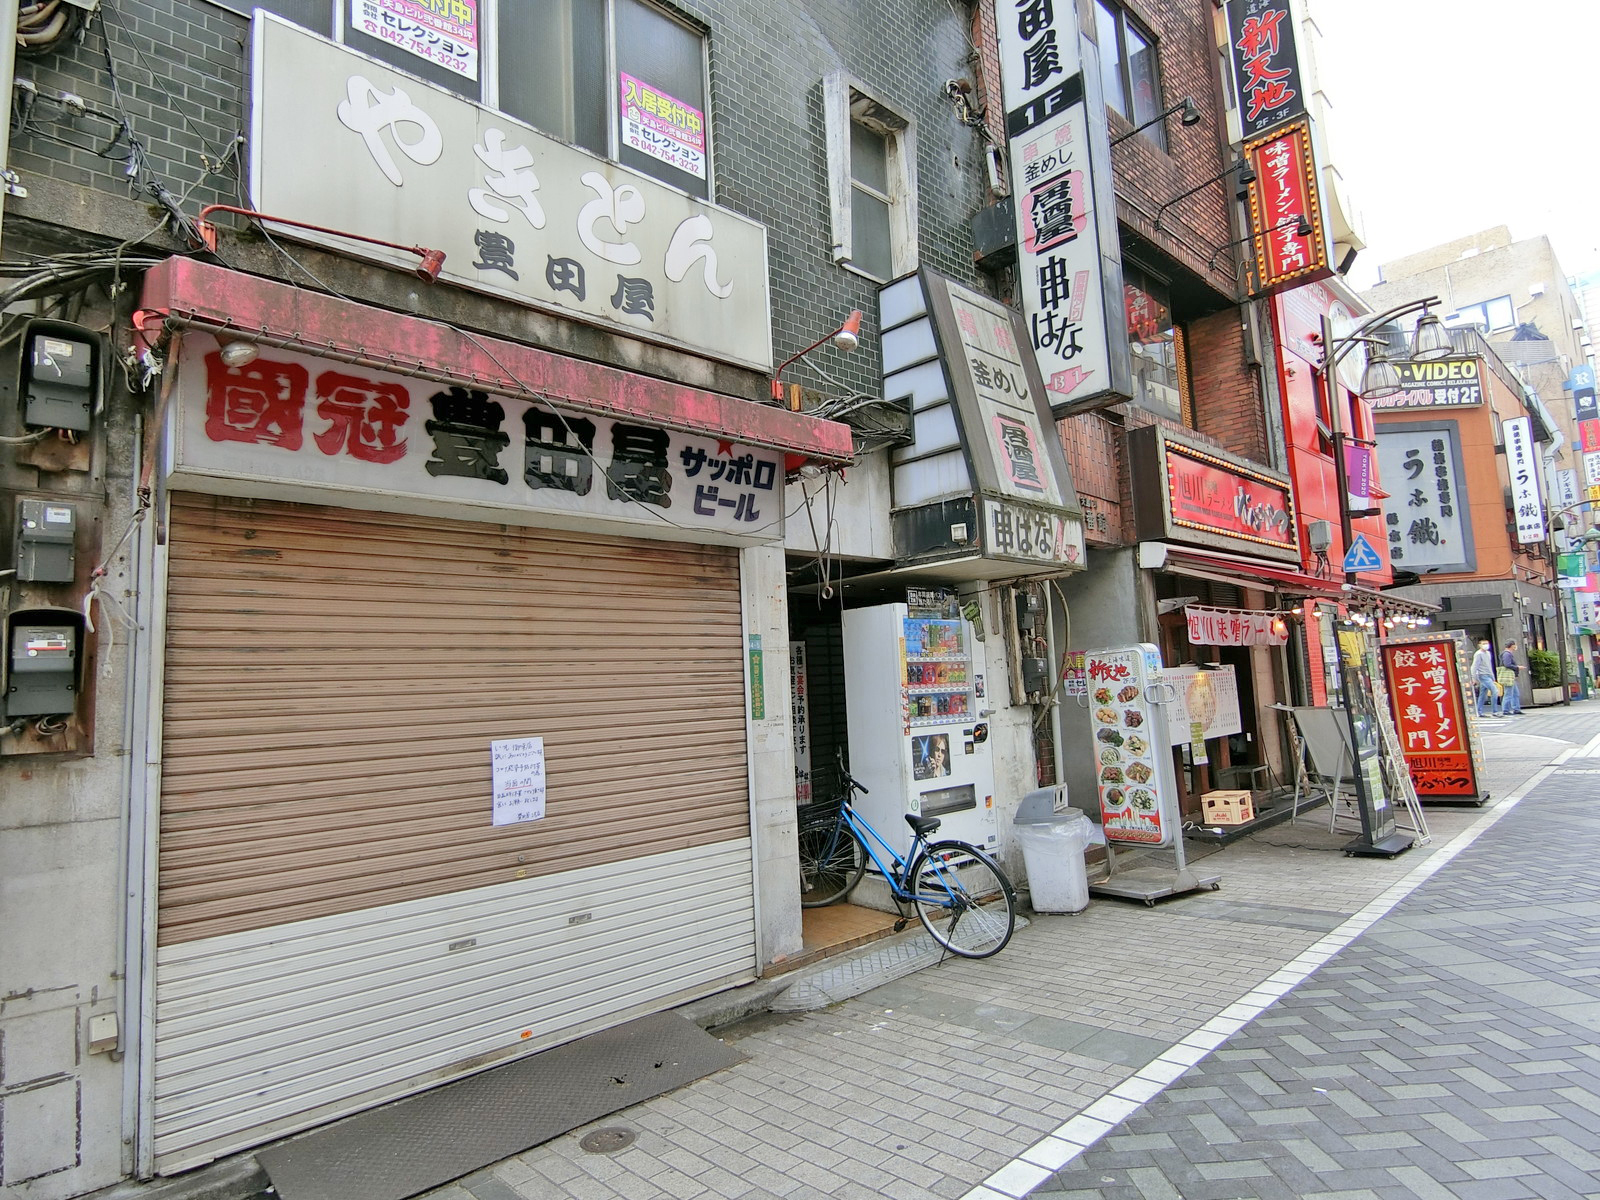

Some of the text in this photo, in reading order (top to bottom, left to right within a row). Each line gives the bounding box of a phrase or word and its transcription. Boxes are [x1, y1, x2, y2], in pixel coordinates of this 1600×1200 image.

[380, 26, 467, 74] 042-754-3232
[381, 10, 470, 58] セレクション
[1236, 9, 1296, 122] 新天地
[625, 79, 702, 135] 入居受付中
[1025, 88, 1063, 126] 1F
[641, 128, 700, 161] セレクション
[641, 140, 699, 174] 042-754-3232
[1025, 148, 1073, 183] 釜めし
[337, 75, 734, 299] やきとん
[1030, 180, 1076, 248] 居酒屋
[1032, 255, 1083, 361] 串はな
[970, 358, 1028, 400] 釜めし
[1053, 370, 1080, 389] B1
[425, 386, 673, 509] 豊田屋
[680, 446, 776, 490] サッポロ
[1000, 421, 1040, 484] 居酒屋
[693, 484, 761, 522] ビール
[1088, 659, 1131, 683] 新天地
[1392, 649, 1431, 750] 餃子専門
[1418, 646, 1456, 750] 味噌ラーメン
[1410, 756, 1437, 768] 旭川
